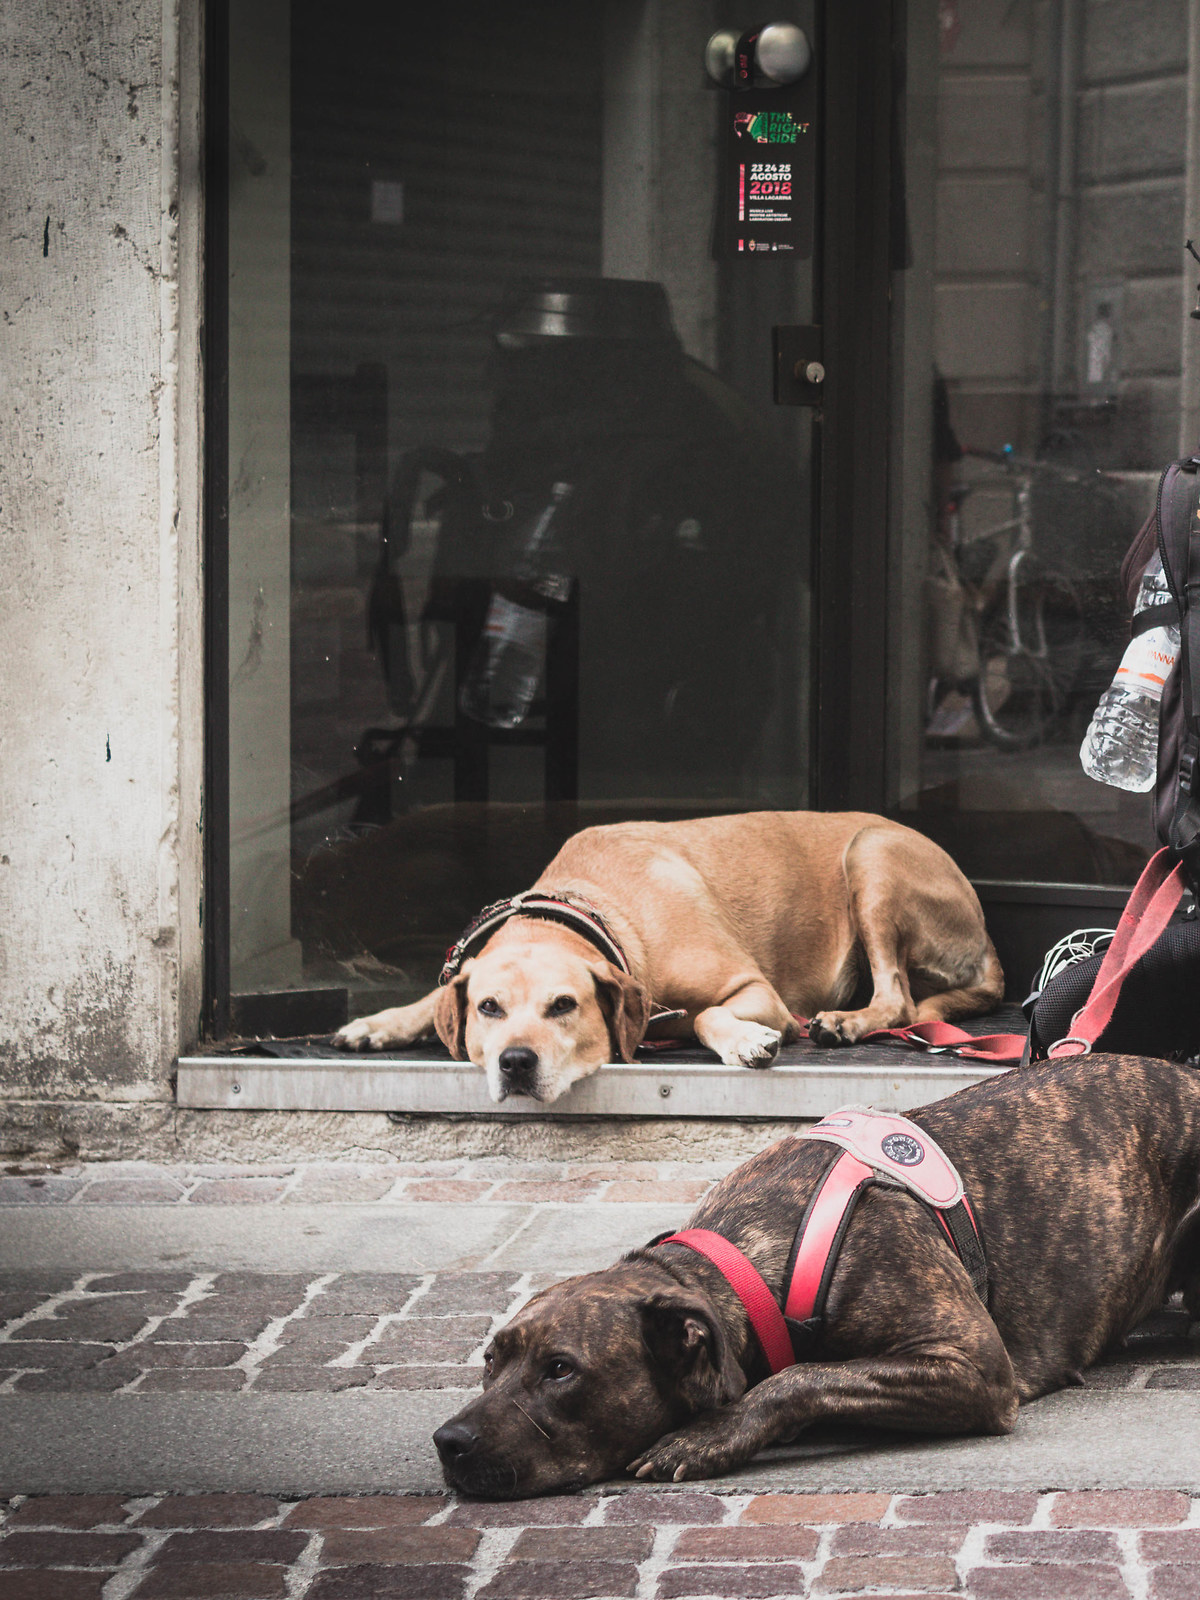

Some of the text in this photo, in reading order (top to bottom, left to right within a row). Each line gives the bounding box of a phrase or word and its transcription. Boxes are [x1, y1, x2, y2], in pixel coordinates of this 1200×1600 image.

[770, 112, 792, 122] THE
[769, 122, 809, 133] RIGHT
[769, 133, 797, 143] SIDE
[751, 164, 791, 172] 23 24 25
[750, 173, 792, 181] AGOSTO
[750, 181, 792, 195] 2018
